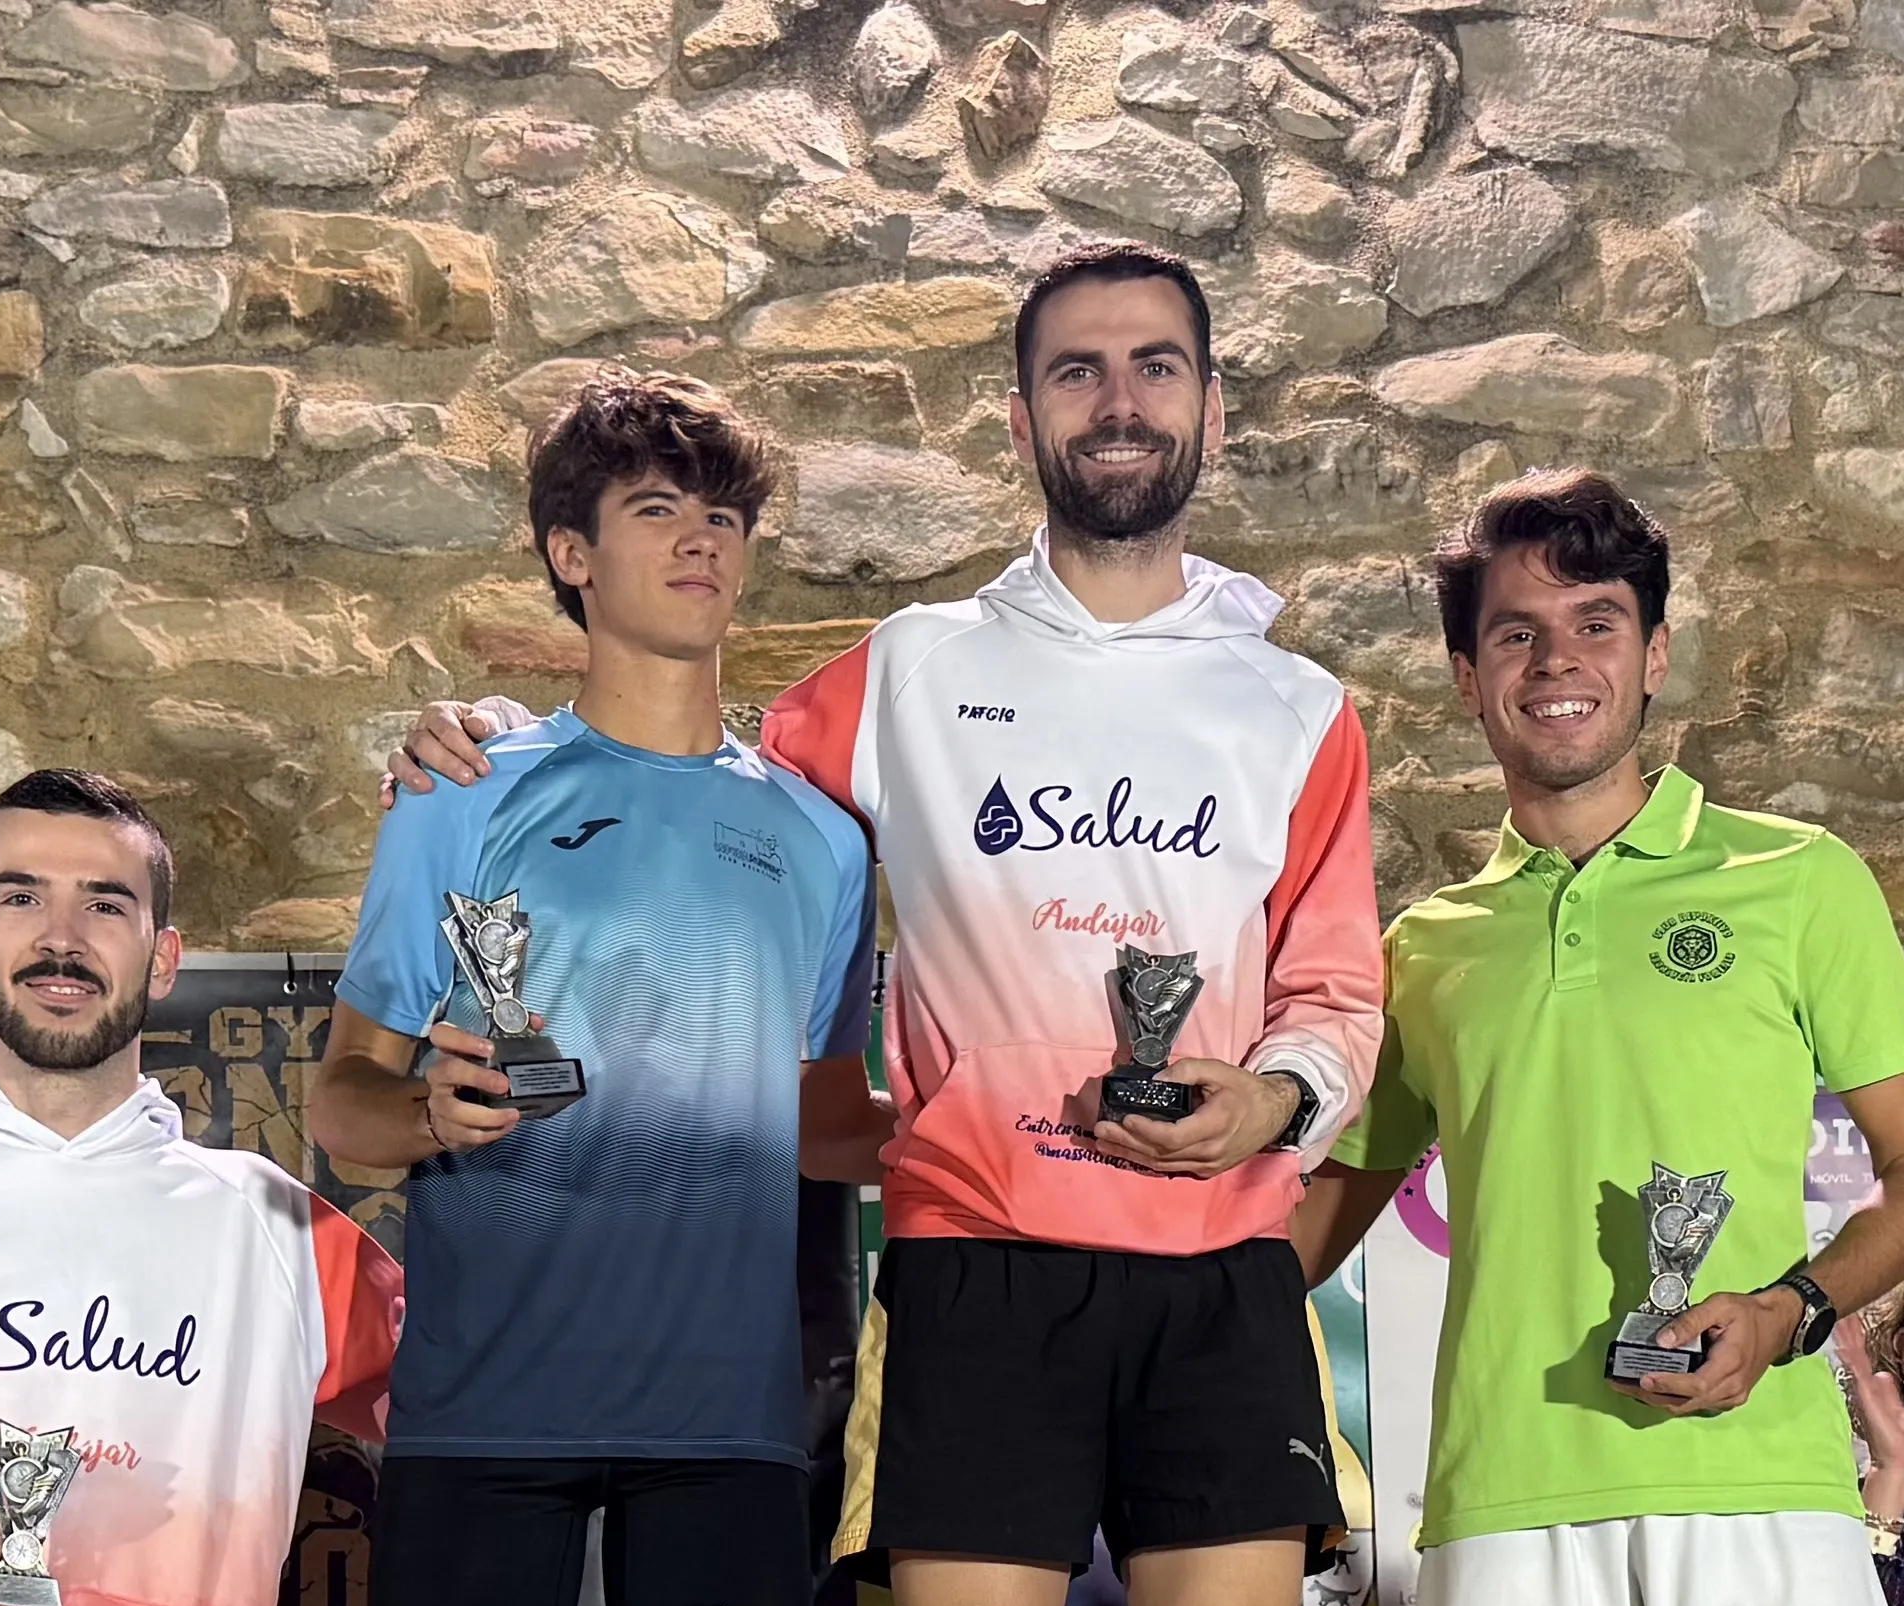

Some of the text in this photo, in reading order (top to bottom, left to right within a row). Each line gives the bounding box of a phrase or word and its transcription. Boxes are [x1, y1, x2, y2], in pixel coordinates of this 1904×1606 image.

[1020, 777, 1220, 858] Salud
[1032, 898, 1166, 943] Andújar
[209, 1006, 333, 1058] GY
[1015, 1113, 1097, 1140] Entrenam
